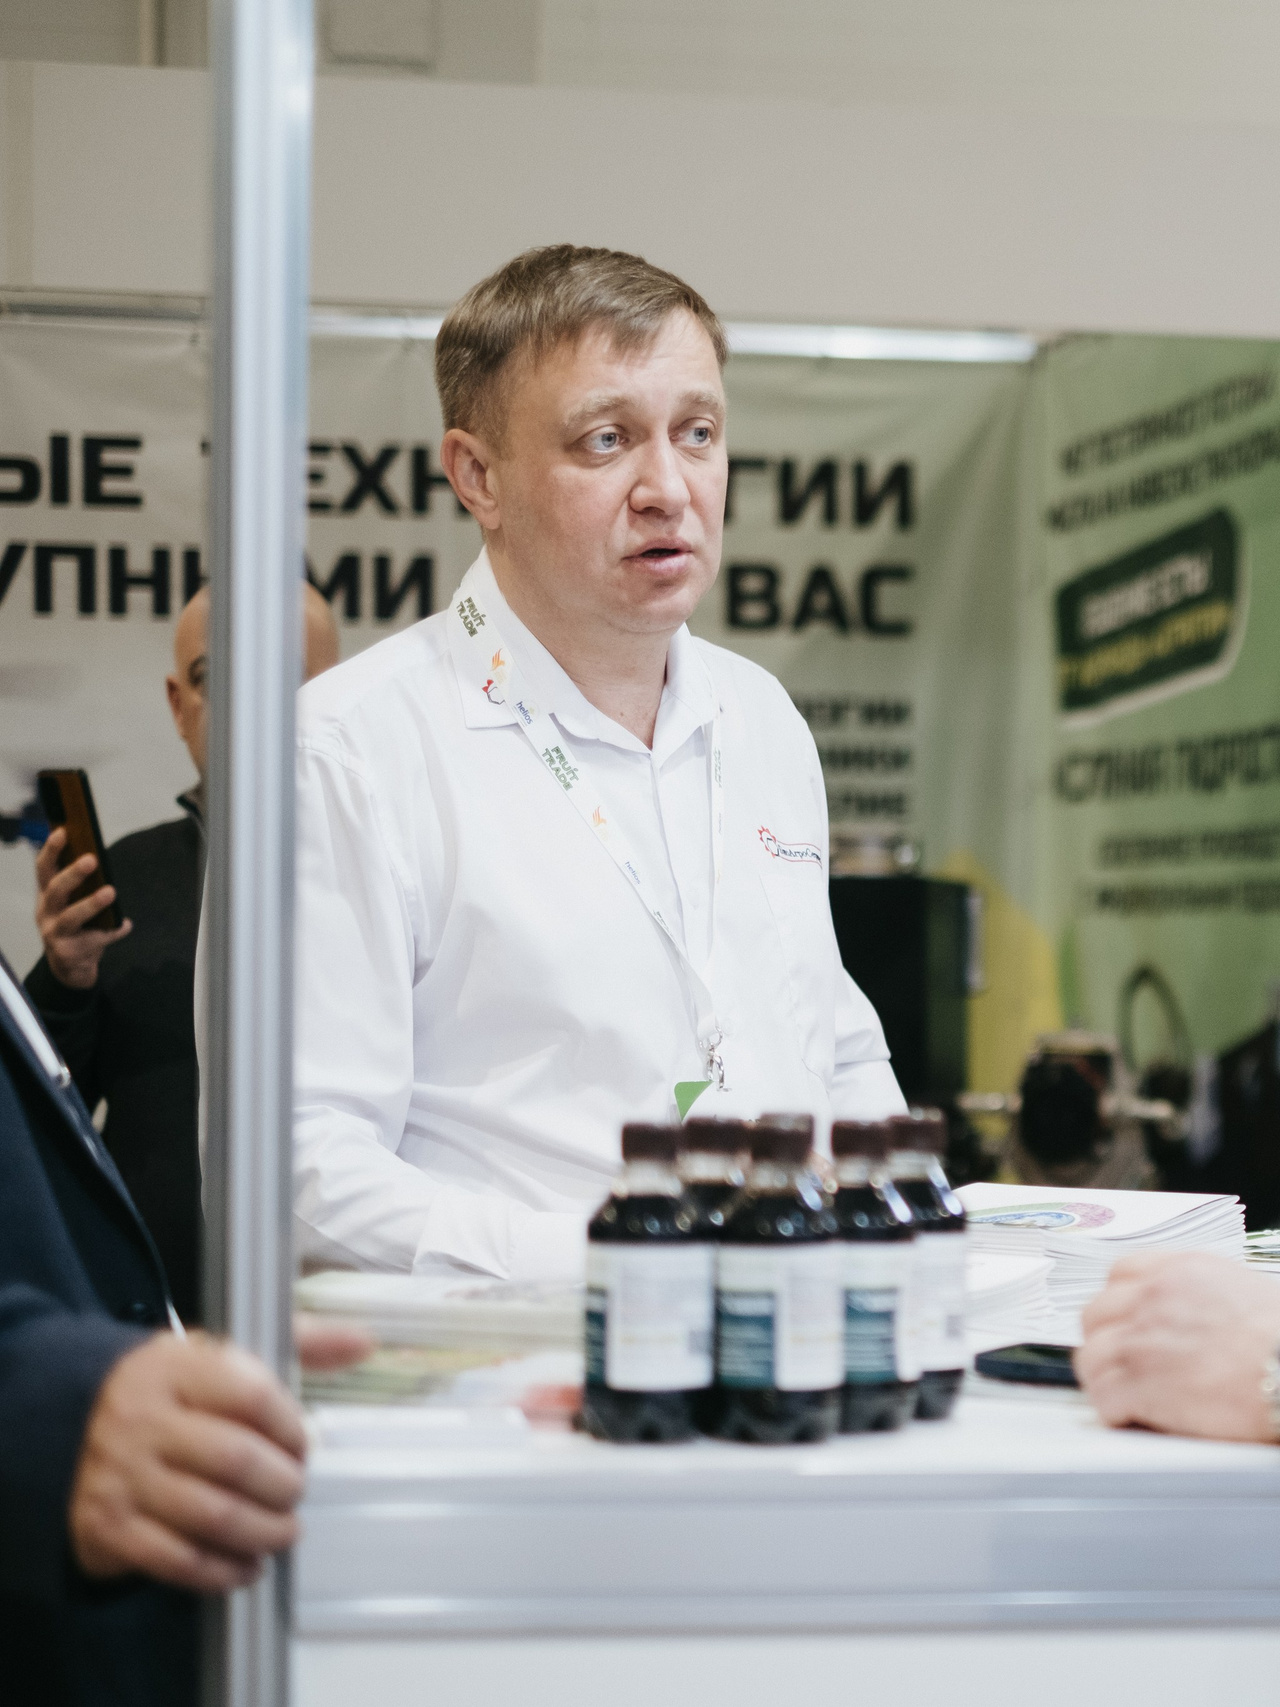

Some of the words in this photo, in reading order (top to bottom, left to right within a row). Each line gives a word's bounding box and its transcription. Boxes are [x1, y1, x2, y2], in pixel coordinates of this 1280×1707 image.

[463, 596, 487, 628] FRUIT
[727, 562, 913, 635] ВАС
[456, 601, 478, 637] TRADE
[516, 701, 533, 725] helios
[541, 747, 574, 791] TRADE
[550, 745, 579, 782] FRUIT
[624, 861, 641, 885] helios
